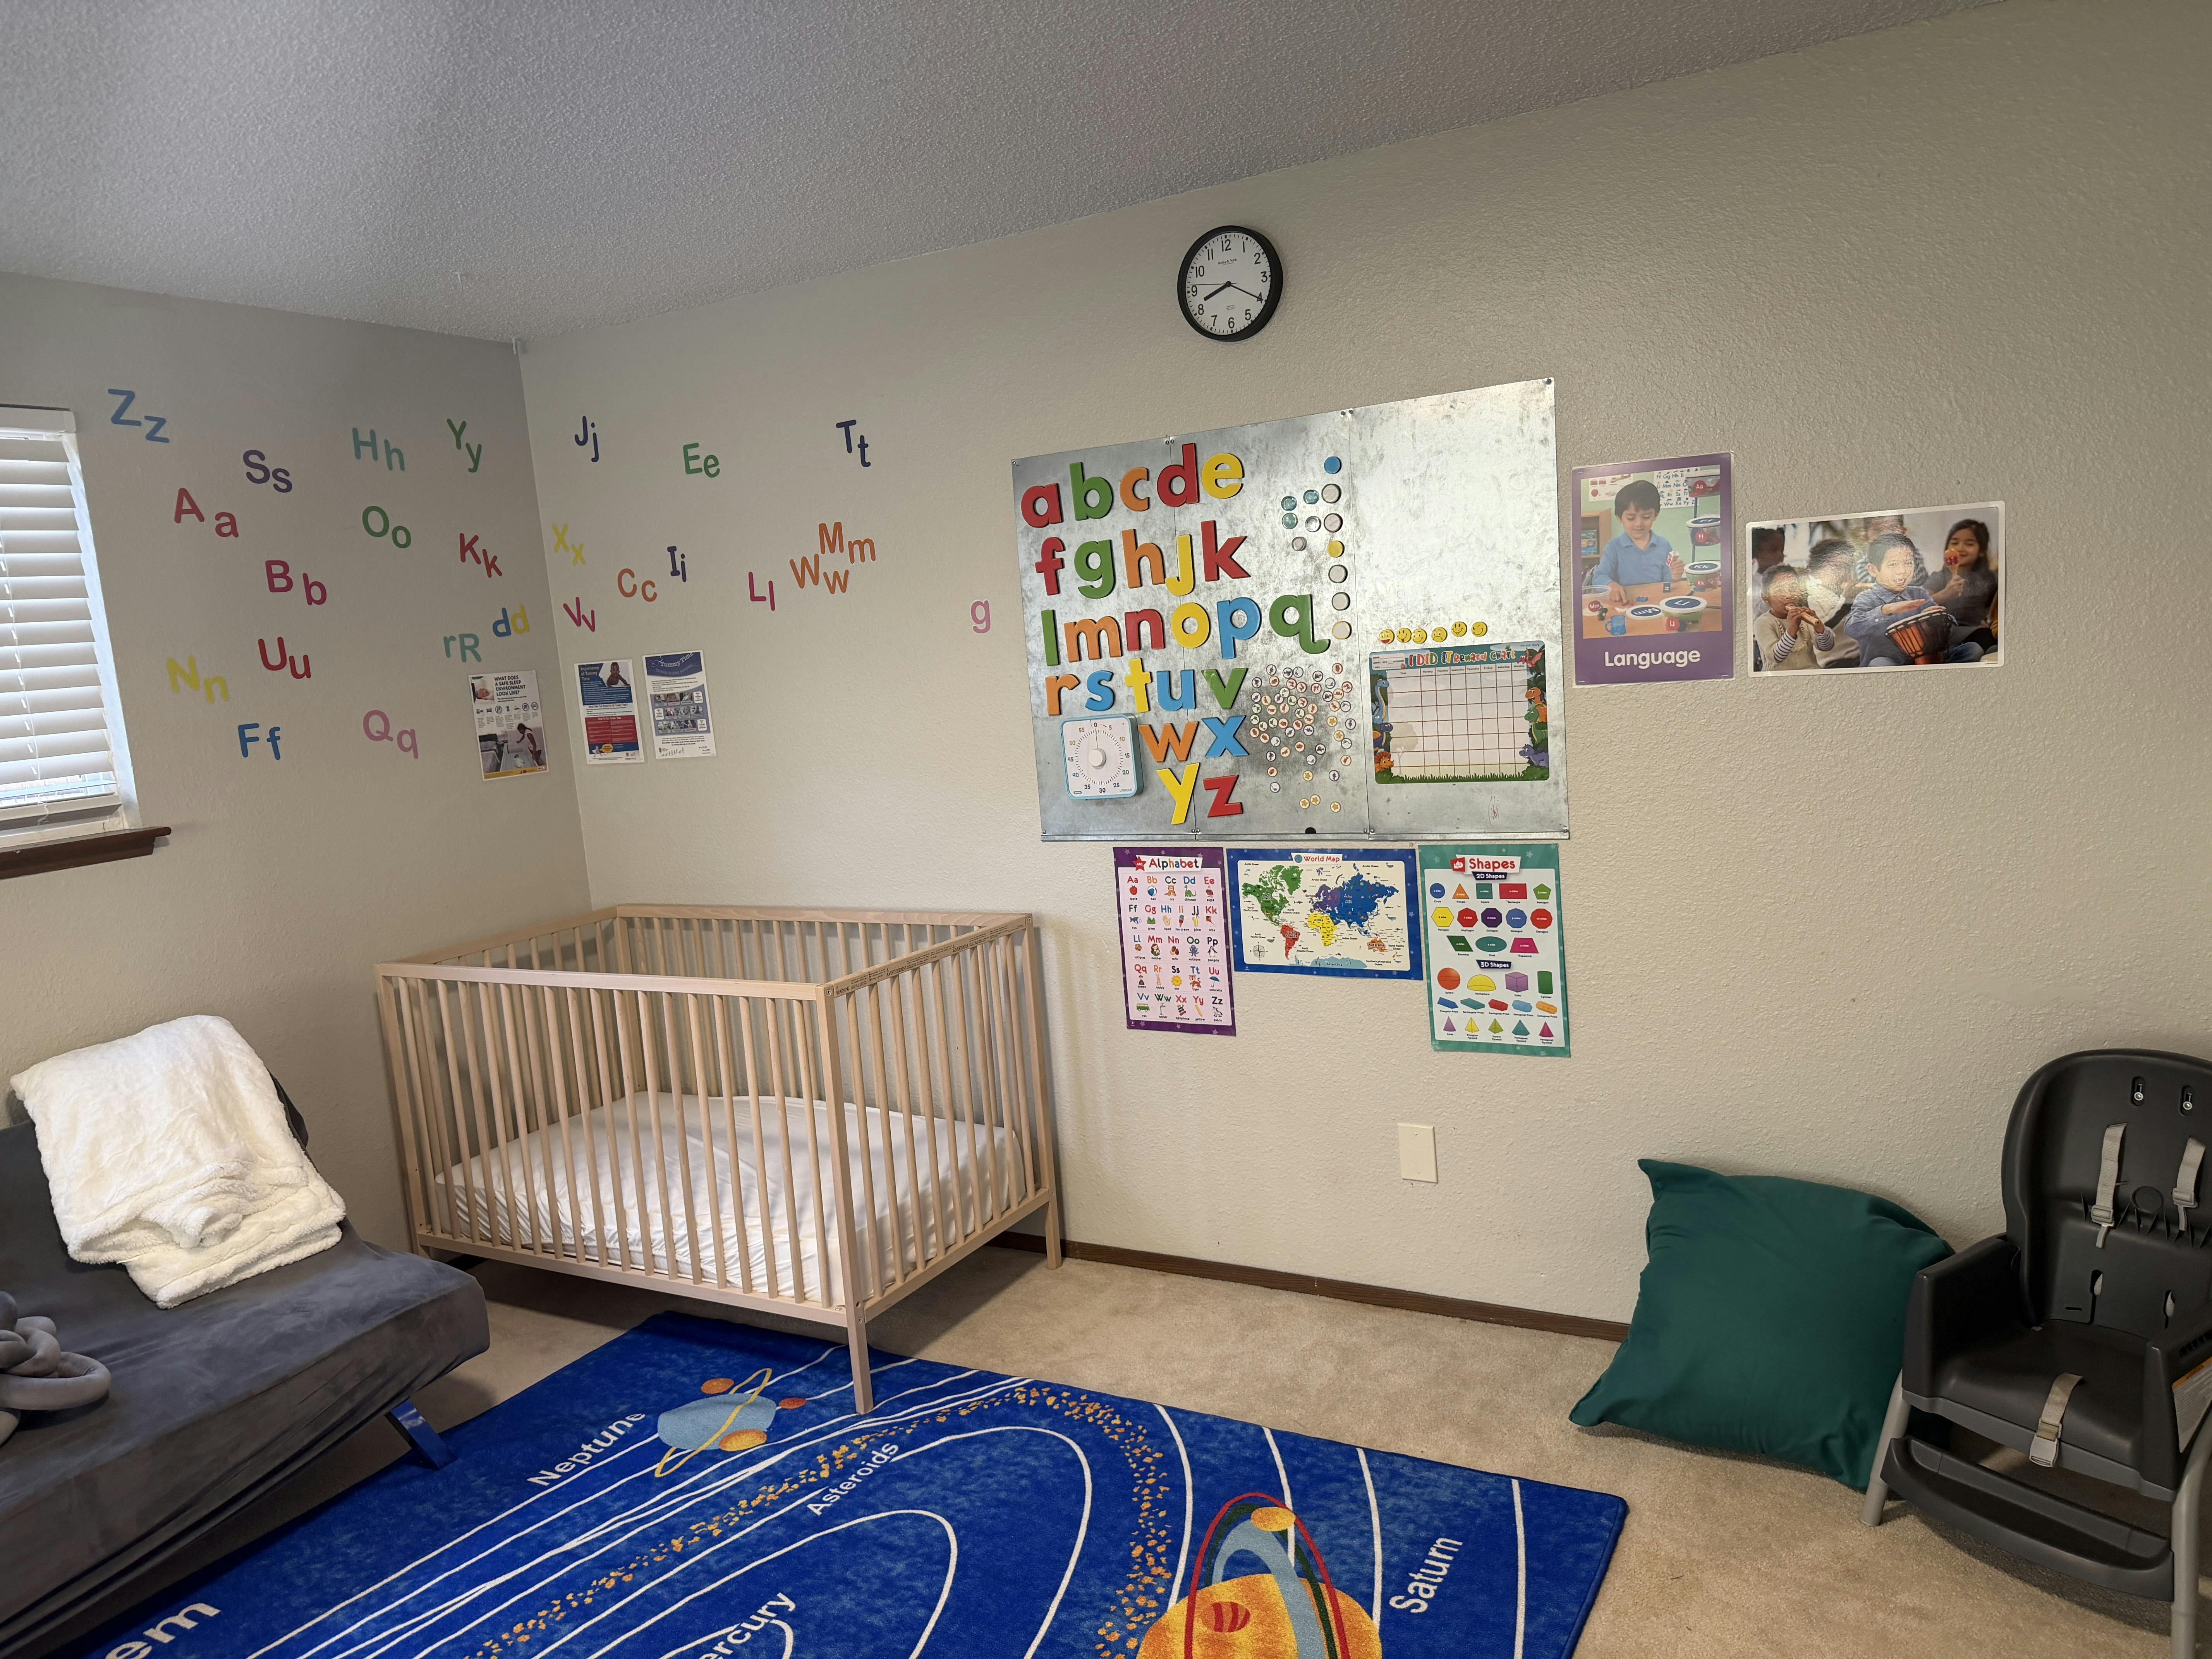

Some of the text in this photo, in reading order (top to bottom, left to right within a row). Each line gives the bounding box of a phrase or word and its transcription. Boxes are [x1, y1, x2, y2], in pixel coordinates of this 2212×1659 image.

[1207, 249, 1213, 260] 11
[1221, 239, 1231, 252] 12
[1243, 241, 1245, 252] 1
[1254, 252, 1261, 264] 2
[1195, 266, 1204, 278] 10
[1261, 271, 1267, 283] 3
[1192, 285, 1197, 297] 9
[1257, 292, 1263, 304] 4
[1198, 304, 1204, 315] 8
[1211, 315, 1217, 326] 7
[1228, 317, 1235, 328] 6
[1245, 309, 1251, 321] 5
[108, 389, 169, 443] Zz
[352, 428, 405, 471] Hh
[447, 419, 482, 472] Yy
[575, 416, 599, 462] Jj
[836, 420, 871, 467] Tt
[243, 450, 292, 493] Ss
[683, 443, 720, 477] Ee
[175, 488, 239, 538] Aa
[362, 506, 411, 548] Oo
[460, 533, 502, 578] Kk
[552, 524, 586, 565] Xx
[818, 522, 876, 564] Mm
[667, 546, 686, 582] Ii
[790, 553, 849, 594] Ww
[265, 560, 326, 605] Bb
[618, 568, 657, 602] Cc
[749, 572, 775, 611] Ll
[493, 604, 530, 637] dd
[563, 597, 595, 632] Vv
[971, 601, 990, 633] g
[258, 637, 311, 679] Uu
[443, 634, 481, 662] rR
[680, 653, 694, 663] Time
[1408, 654, 1413, 666] I
[1416, 652, 1438, 666] DID
[1441, 651, 1453, 664] IT
[1605, 649, 1700, 669] Language
[167, 656, 229, 703] Nn
[238, 723, 280, 760] Ff
[363, 710, 418, 759] Qq
[1149, 858, 1199, 870] Alphabet
[1204, 876, 1214, 884] Ee
[1469, 858, 1515, 871] Shapes
[1145, 905, 1156, 914] Gg
[1192, 905, 1199, 916] Jj
[1206, 906, 1217, 914] Kk
[1148, 935, 1163, 943] Mm
[1168, 936, 1179, 944] Nn
[1207, 937, 1218, 946] Pp
[1134, 964, 1147, 974] Qq
[1171, 965, 1180, 974] Ss
[1209, 967, 1219, 975] Uu
[1154, 993, 1171, 1002] Ww
[1193, 996, 1204, 1005] Yy
[1211, 996, 1223, 1005] Zz
[527, 1410, 646, 1487] Neptune
[806, 1441, 898, 1516] Asteroids
[1389, 1537, 1463, 1613] Saturn
